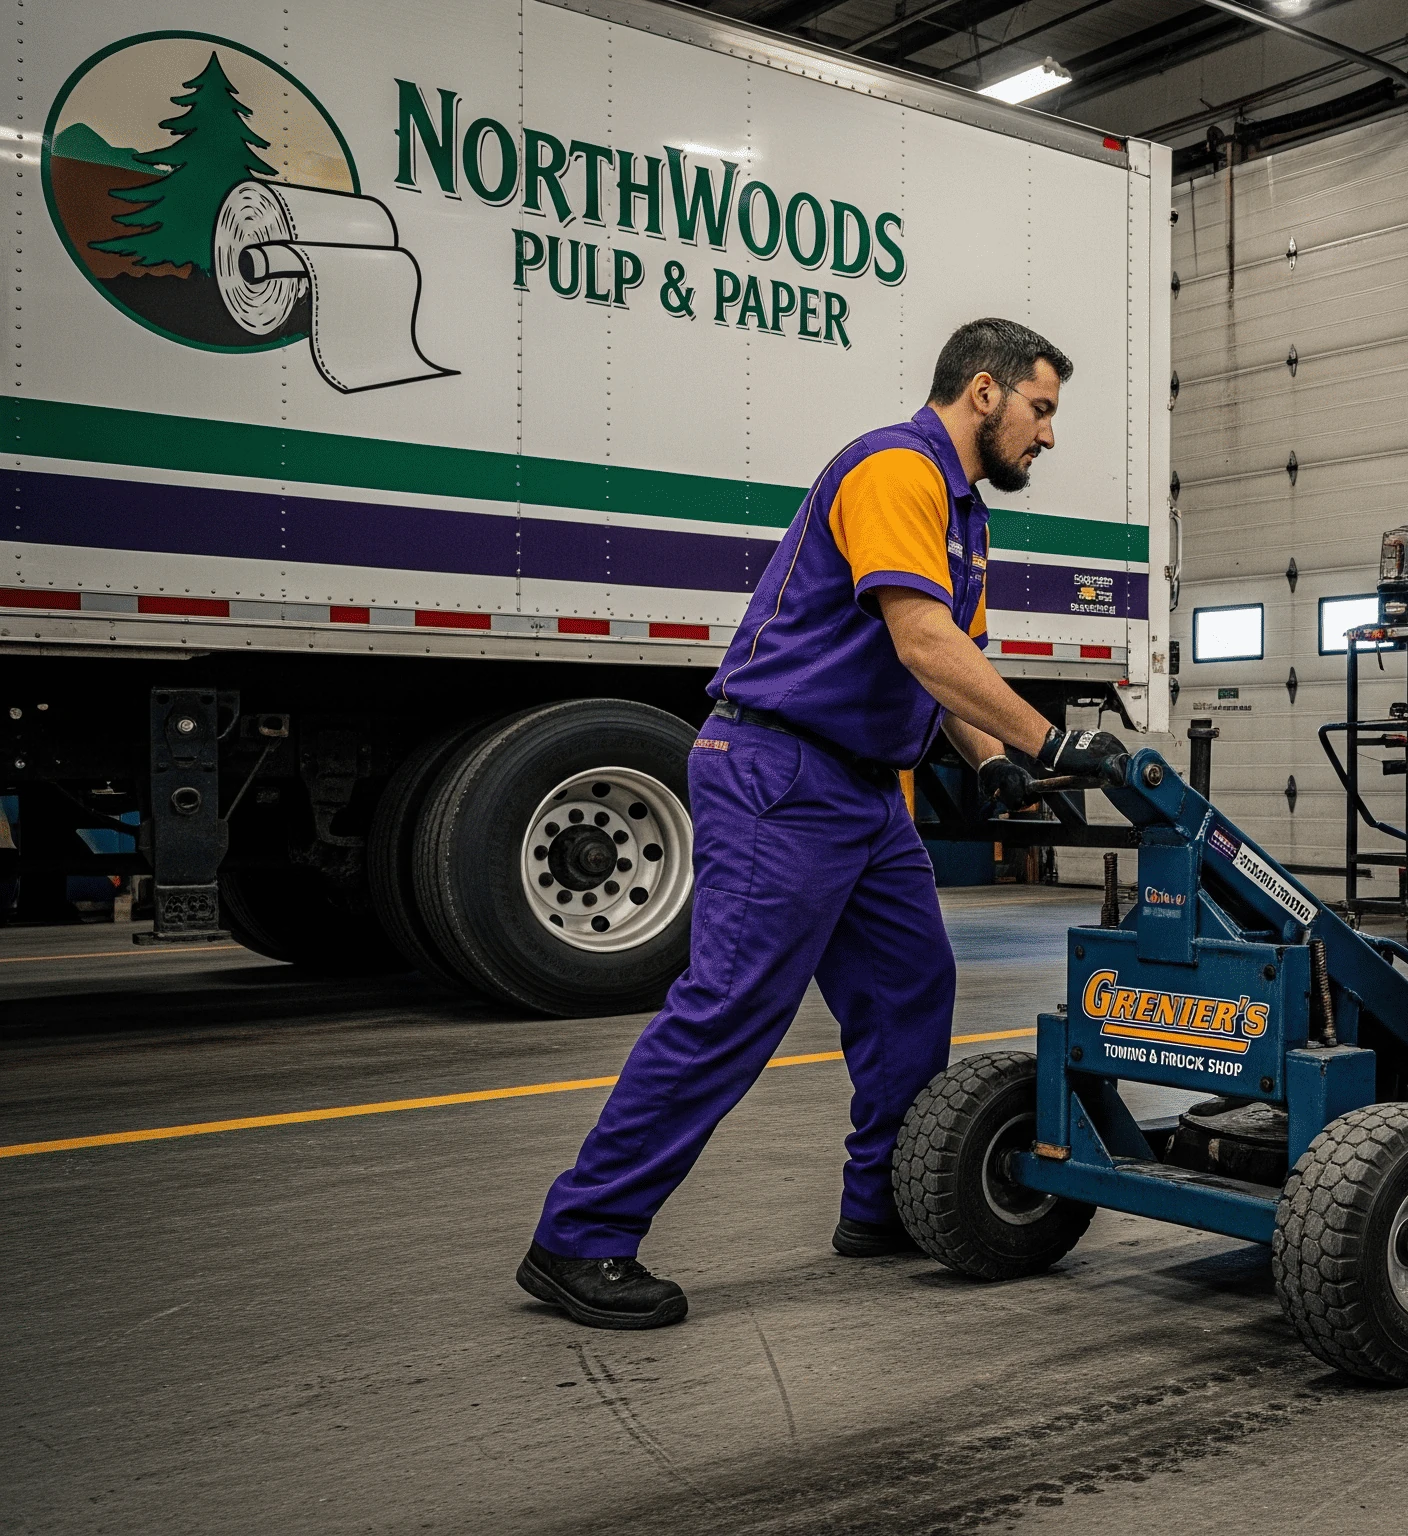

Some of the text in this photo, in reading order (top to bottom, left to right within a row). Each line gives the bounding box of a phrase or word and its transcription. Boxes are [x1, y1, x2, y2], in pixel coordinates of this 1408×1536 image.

[393, 77, 907, 288] NORTHWOODS
[511, 228, 853, 351] PULP & PAPER
[1081, 968, 1270, 1039] GRENIER'S
[1207, 1058, 1243, 1077] SHOP
